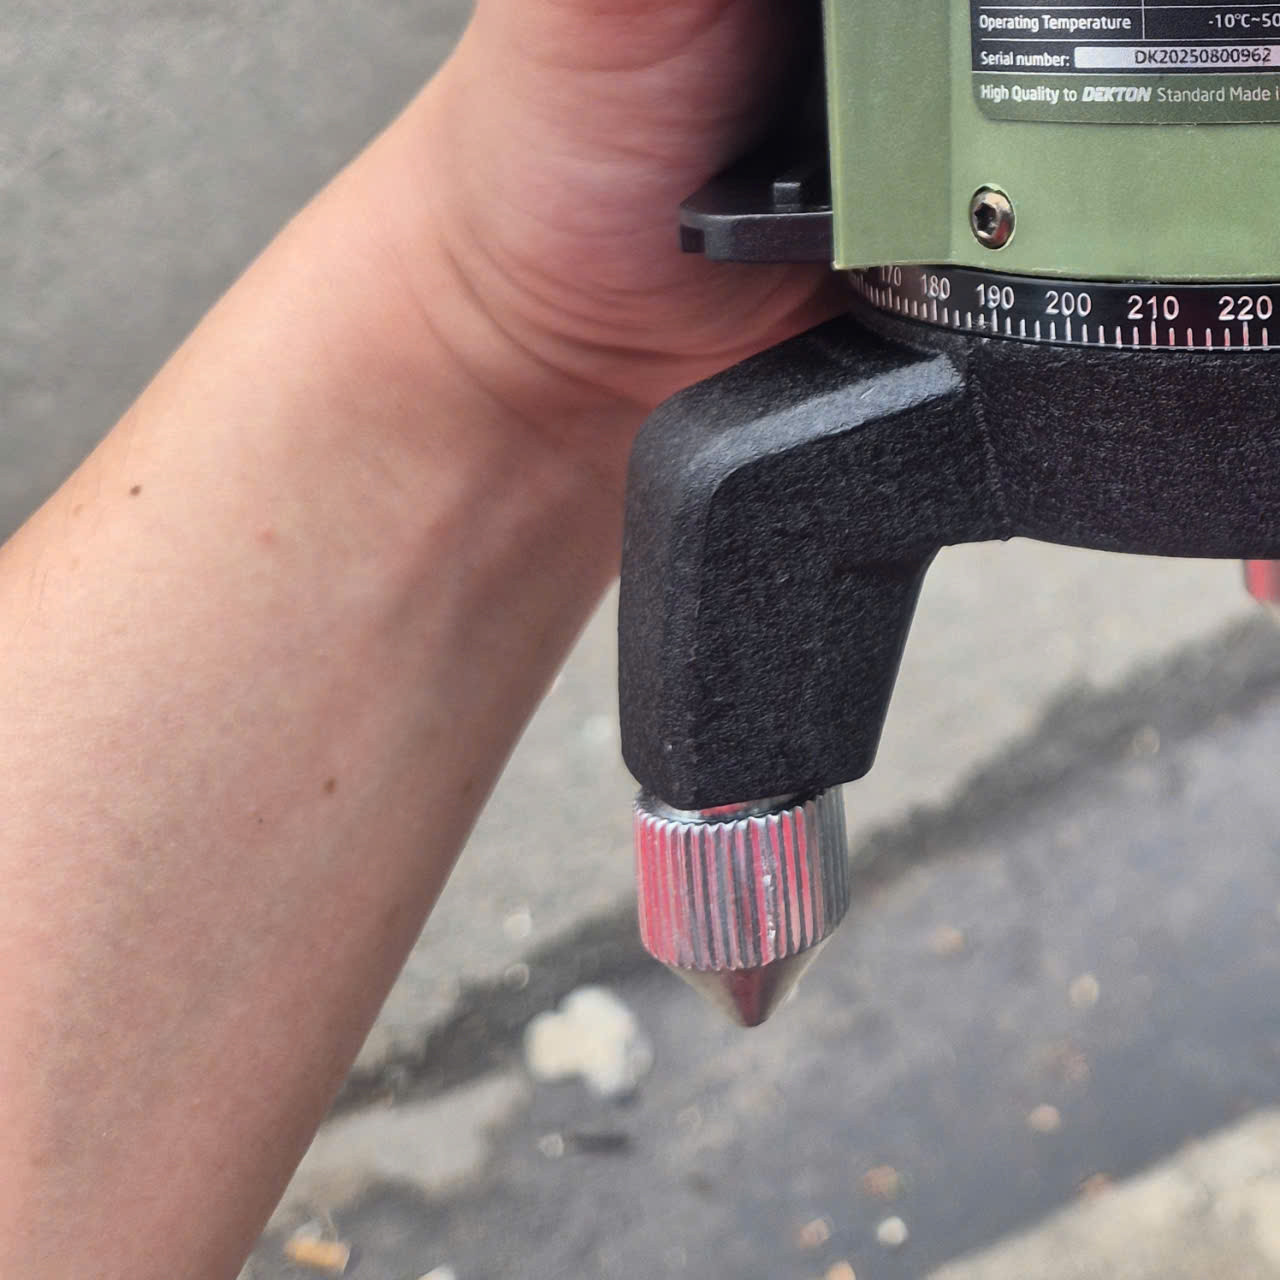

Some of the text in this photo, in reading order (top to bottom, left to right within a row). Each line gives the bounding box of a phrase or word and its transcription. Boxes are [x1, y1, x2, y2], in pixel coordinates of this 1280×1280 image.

[980, 15, 1132, 32] Operating Temperature
[981, 48, 1271, 67] Serial number: DK20250800962
[981, 85, 1011, 102] High
[1013, 86, 1060, 104] Quality
[1062, 87, 1077, 101] to
[1081, 87, 1152, 102] DEKTON
[1157, 87, 1226, 102] Standard
[1229, 87, 1271, 101] Made
[921, 273, 950, 301] 180
[976, 283, 1015, 309] 190
[1045, 291, 1092, 317] 200
[1127, 295, 1180, 321] 210
[1218, 295, 1273, 320] 220
